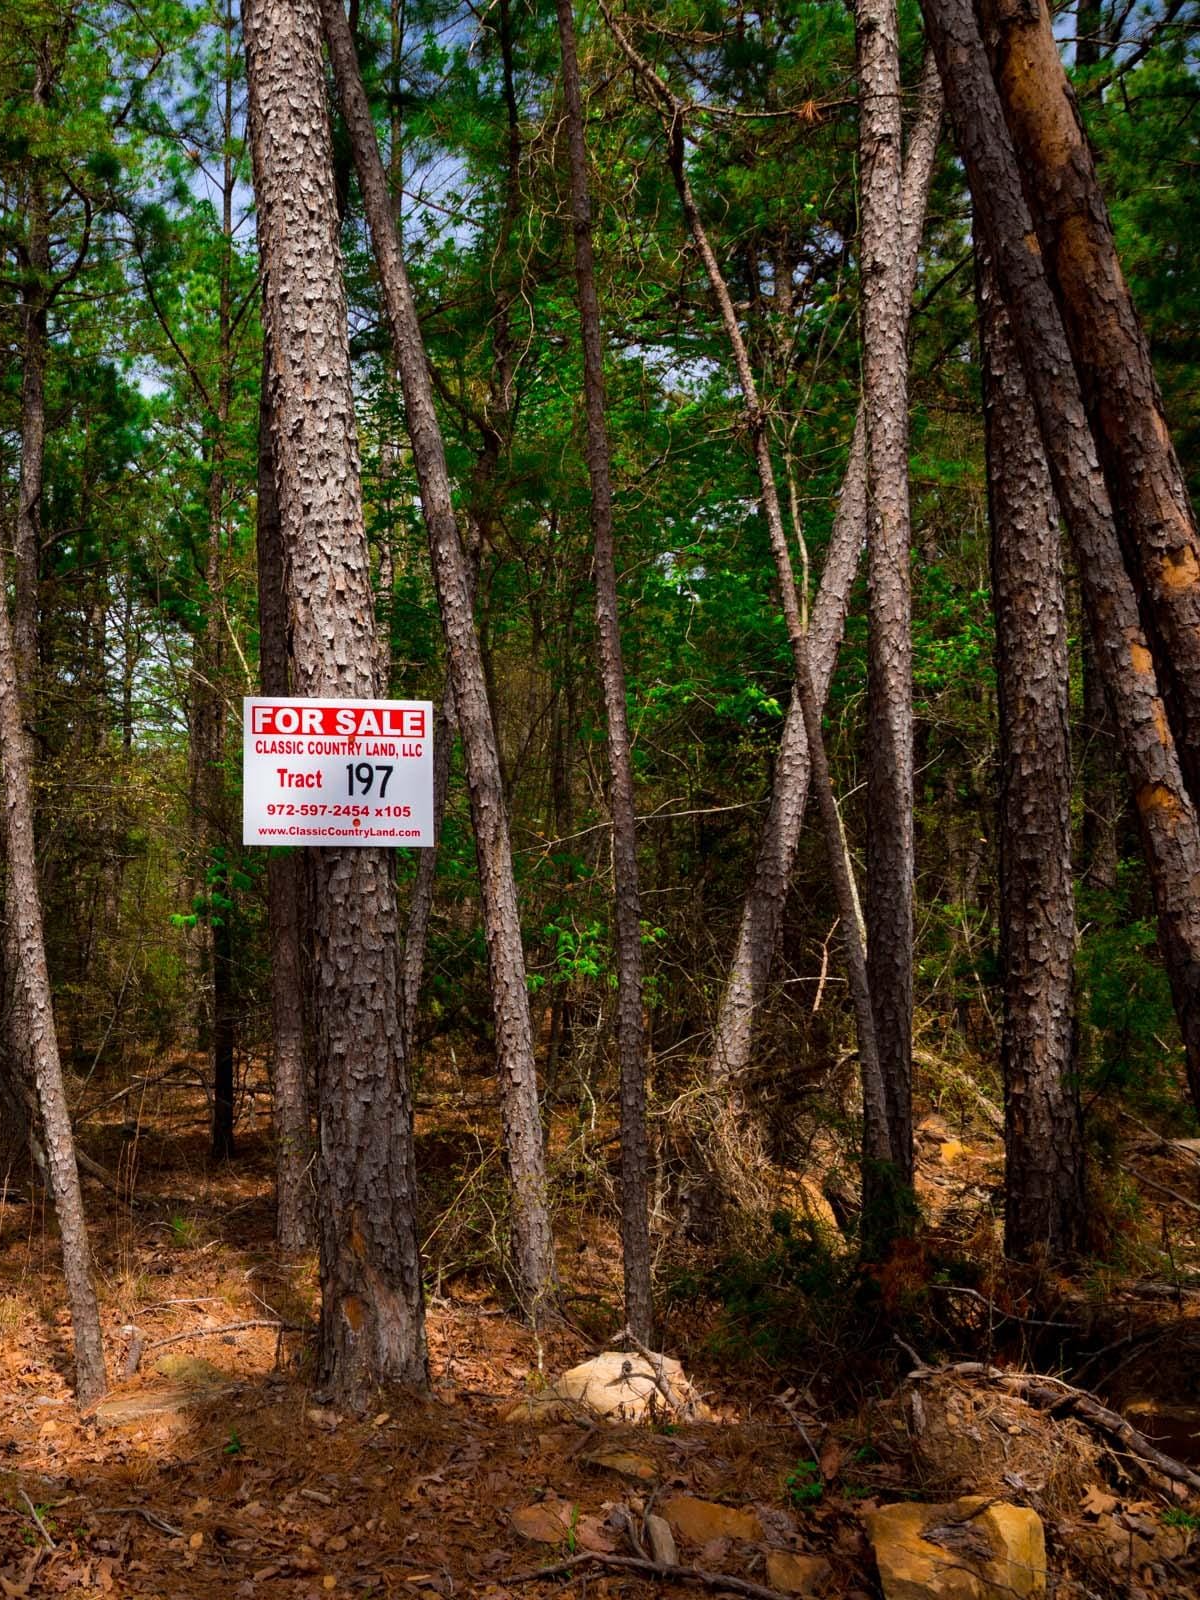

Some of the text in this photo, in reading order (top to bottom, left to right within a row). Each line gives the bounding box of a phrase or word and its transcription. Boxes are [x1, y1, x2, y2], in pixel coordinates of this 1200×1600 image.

[254, 708, 422, 736] FOR SALE
[256, 741, 422, 759] CLASSIC COUNTRY LAND, LLC
[277, 763, 393, 798] Tract 197
[267, 804, 411, 817] 972-597-2454 x105
[258, 826, 420, 837] www.ClassicCountryLand.com
